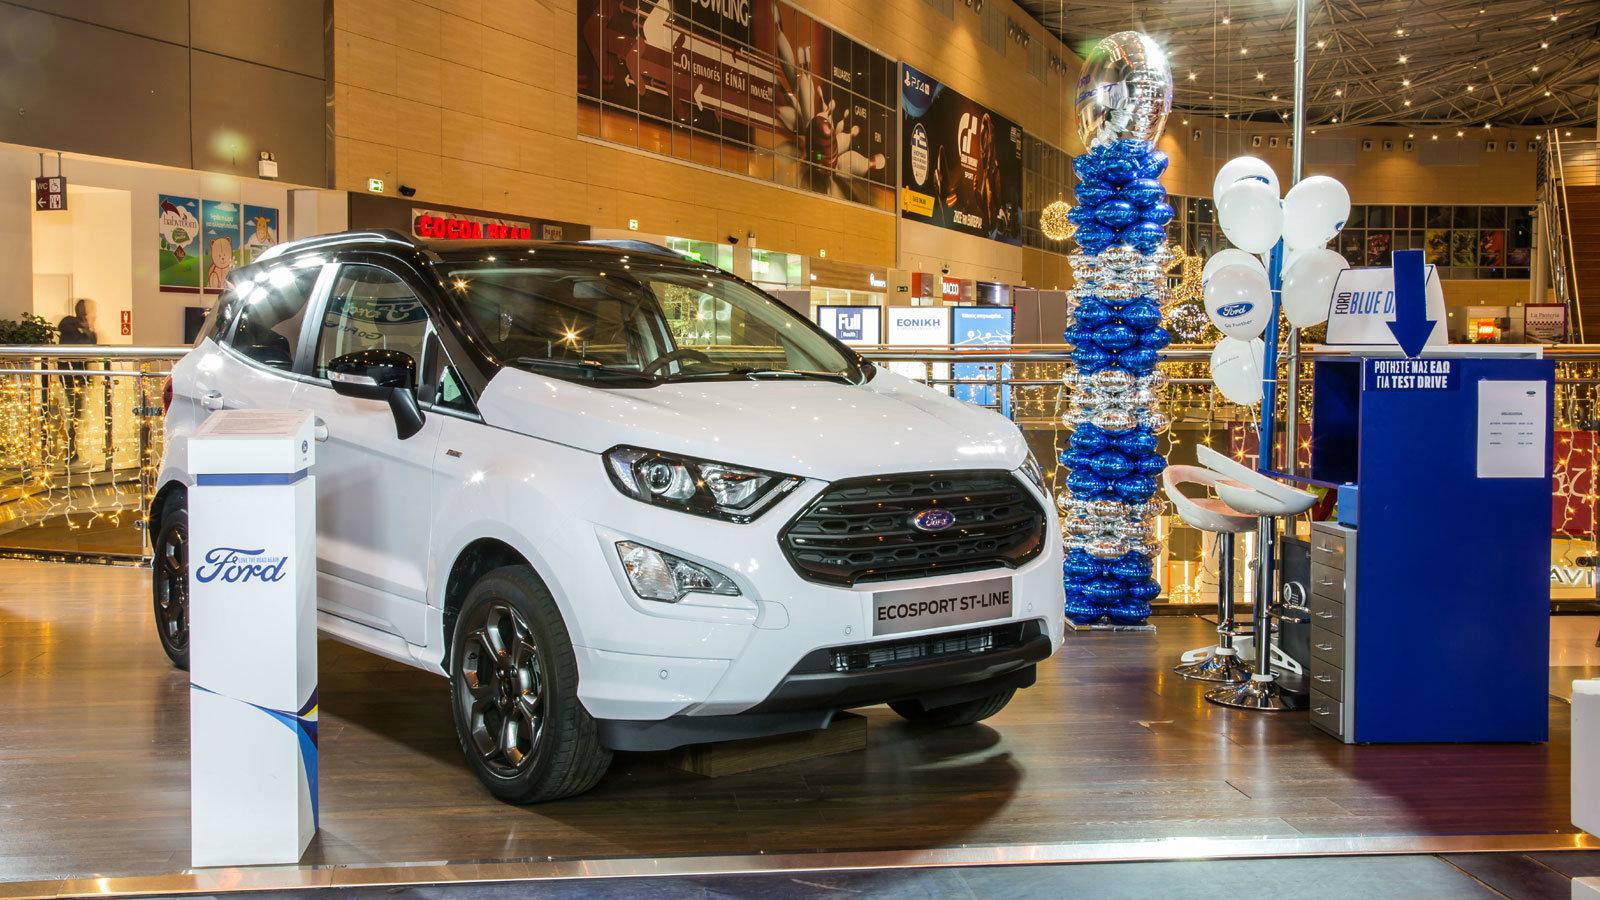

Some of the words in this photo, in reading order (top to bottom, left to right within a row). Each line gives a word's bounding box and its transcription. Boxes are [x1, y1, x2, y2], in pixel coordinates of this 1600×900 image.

[691, 0, 749, 27] LING
[36, 182, 49, 191] WC
[420, 214, 483, 240] COCOA
[1222, 304, 1247, 316] Ford
[1334, 292, 1352, 315] FORD
[1349, 291, 1383, 315] BLUE
[1374, 360, 1410, 374] ΡΩΤΗΣΤΕ
[1411, 360, 1428, 374] ΜΑΣ
[1430, 360, 1451, 374] ΕΔΩ
[1376, 375, 1390, 389] ΓΙΑ
[1391, 375, 1415, 389] TEST
[1417, 375, 1448, 389] DRIVE
[195, 547, 289, 583] Ford
[877, 597, 957, 621] ECOSPORT
[959, 590, 1010, 611] ST-LINE
